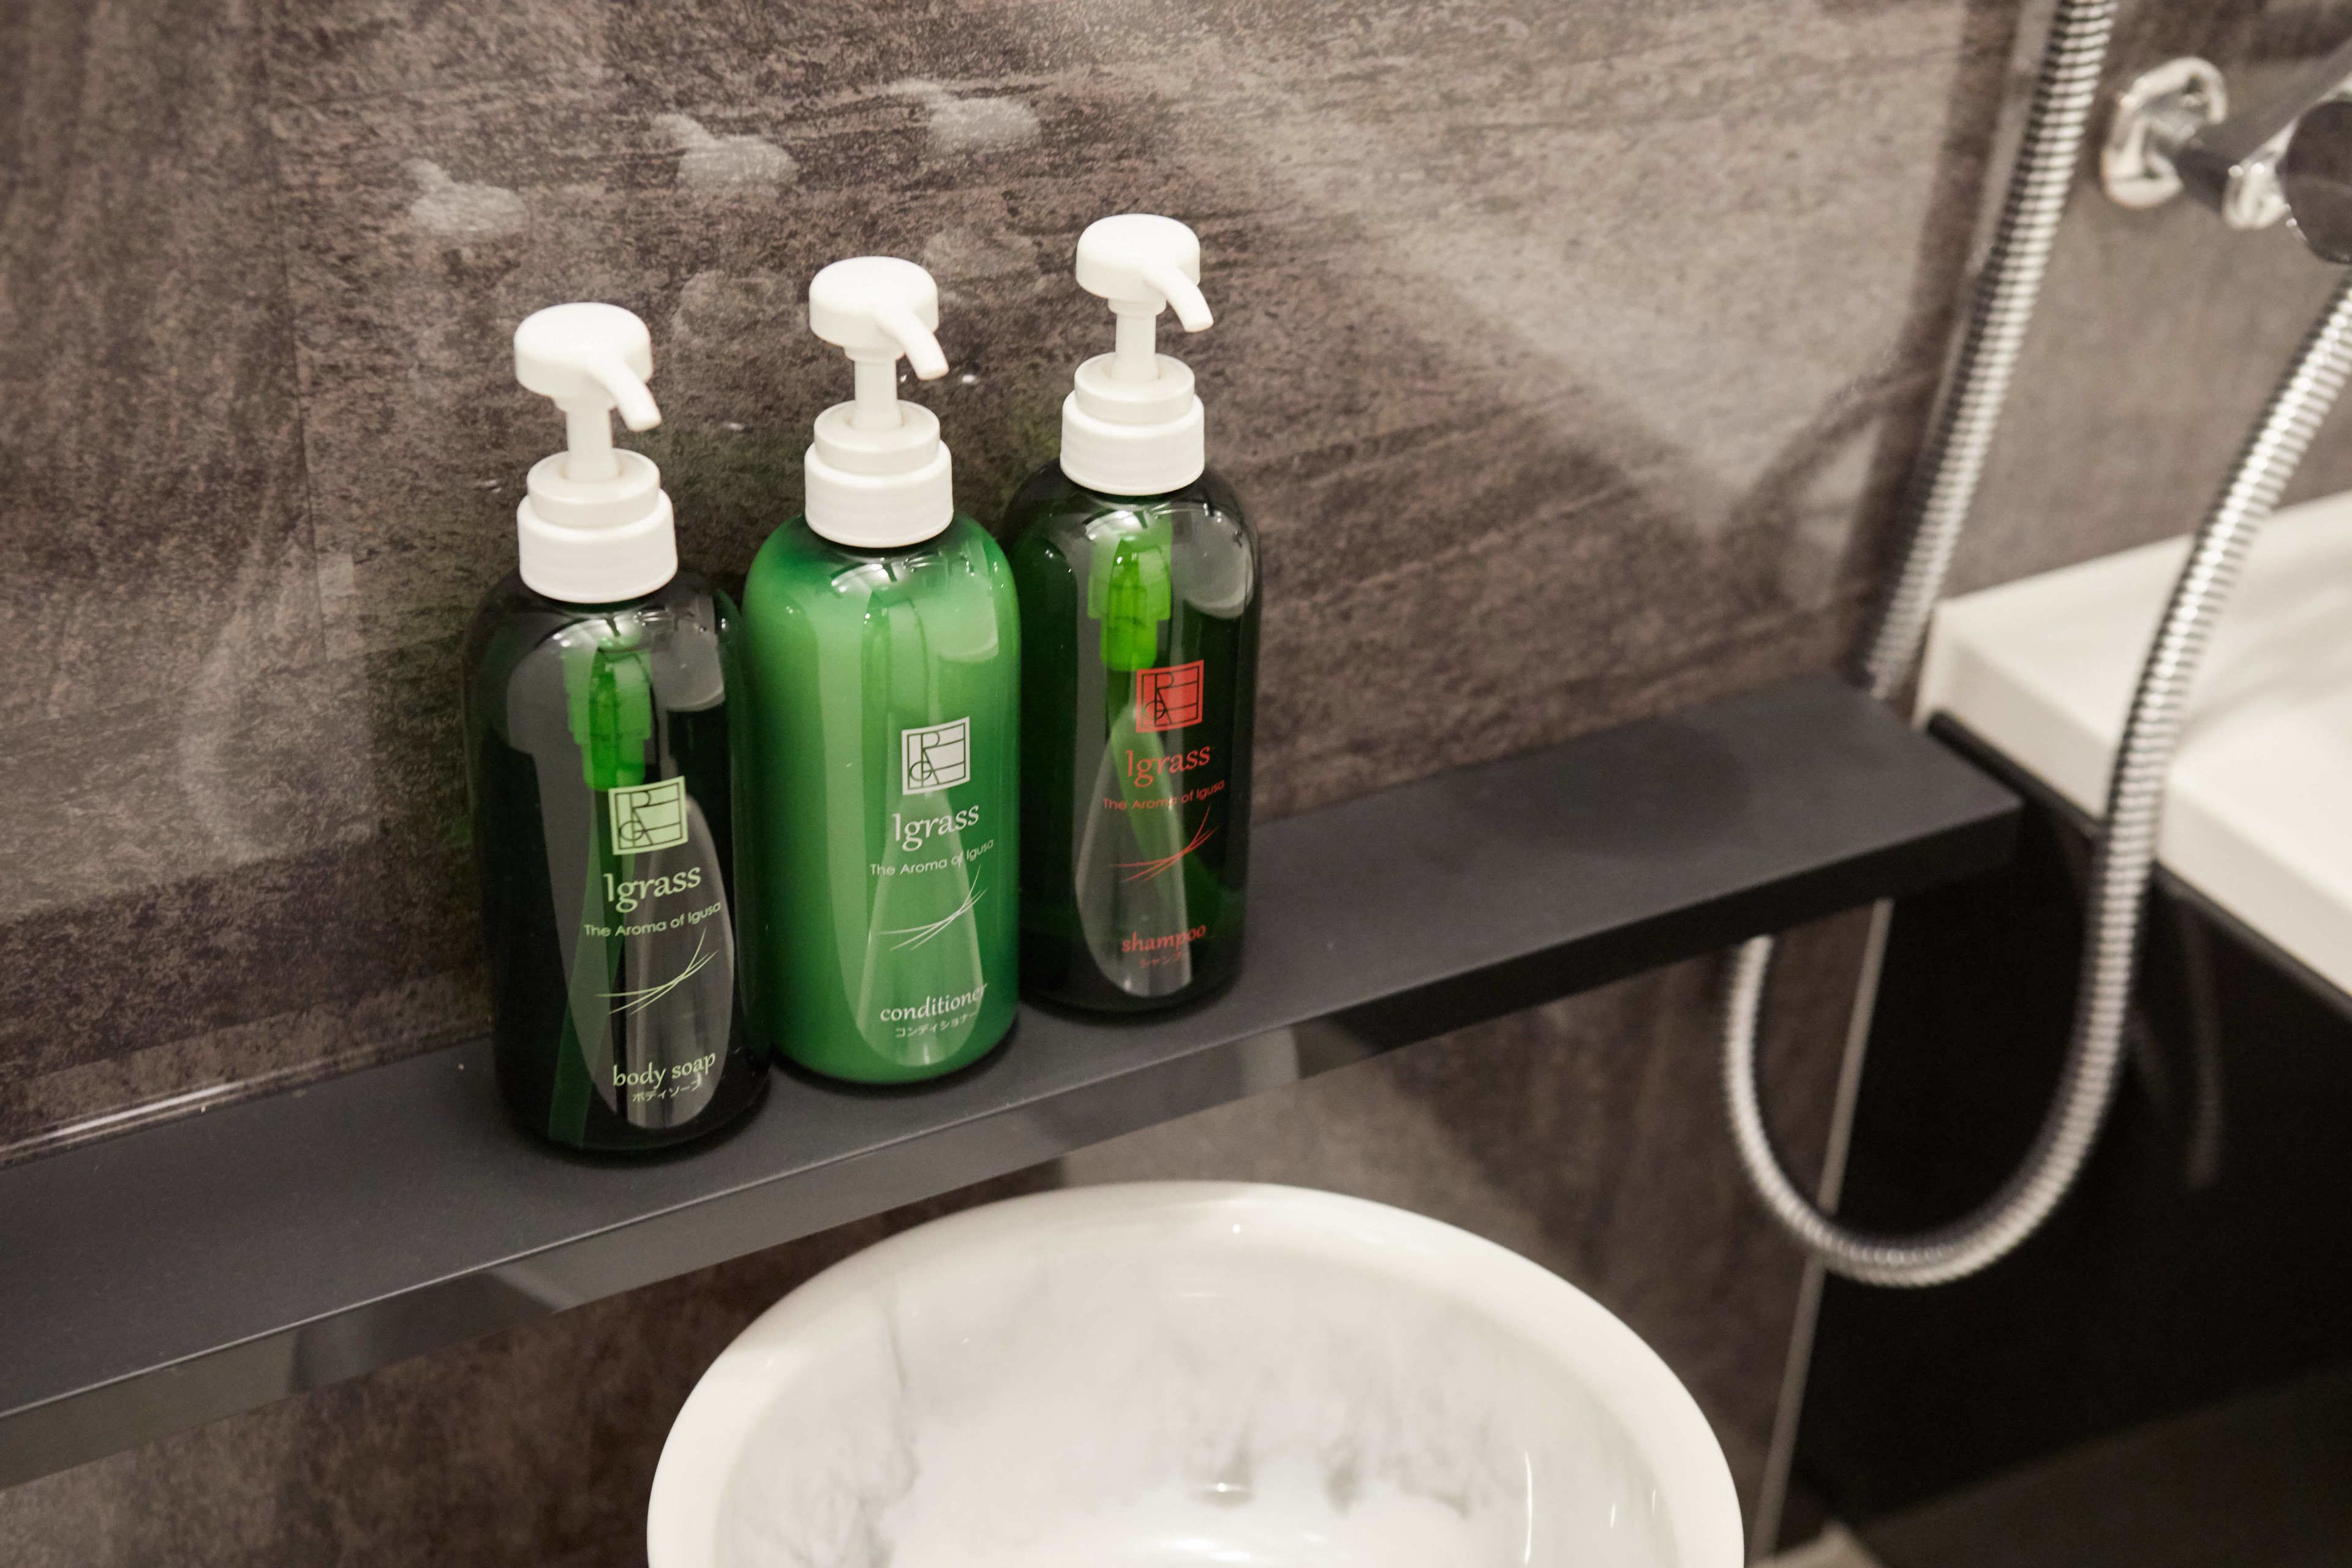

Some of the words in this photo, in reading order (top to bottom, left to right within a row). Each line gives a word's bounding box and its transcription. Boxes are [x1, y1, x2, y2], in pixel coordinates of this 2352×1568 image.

[1102, 797, 1127, 810] The
[1131, 797, 1178, 809] Aroma
[1180, 790, 1194, 802] of
[870, 863, 895, 876] The
[900, 858, 948, 875] Aroma
[951, 852, 964, 867] of
[584, 924, 611, 937] The
[615, 921, 666, 937] Aroma
[670, 914, 685, 929] of
[688, 902, 721, 925] Igusa
[1121, 924, 1206, 953] shampoo
[880, 982, 987, 1022] conditioner
[612, 1061, 666, 1089] body
[672, 1052, 716, 1079] soap
